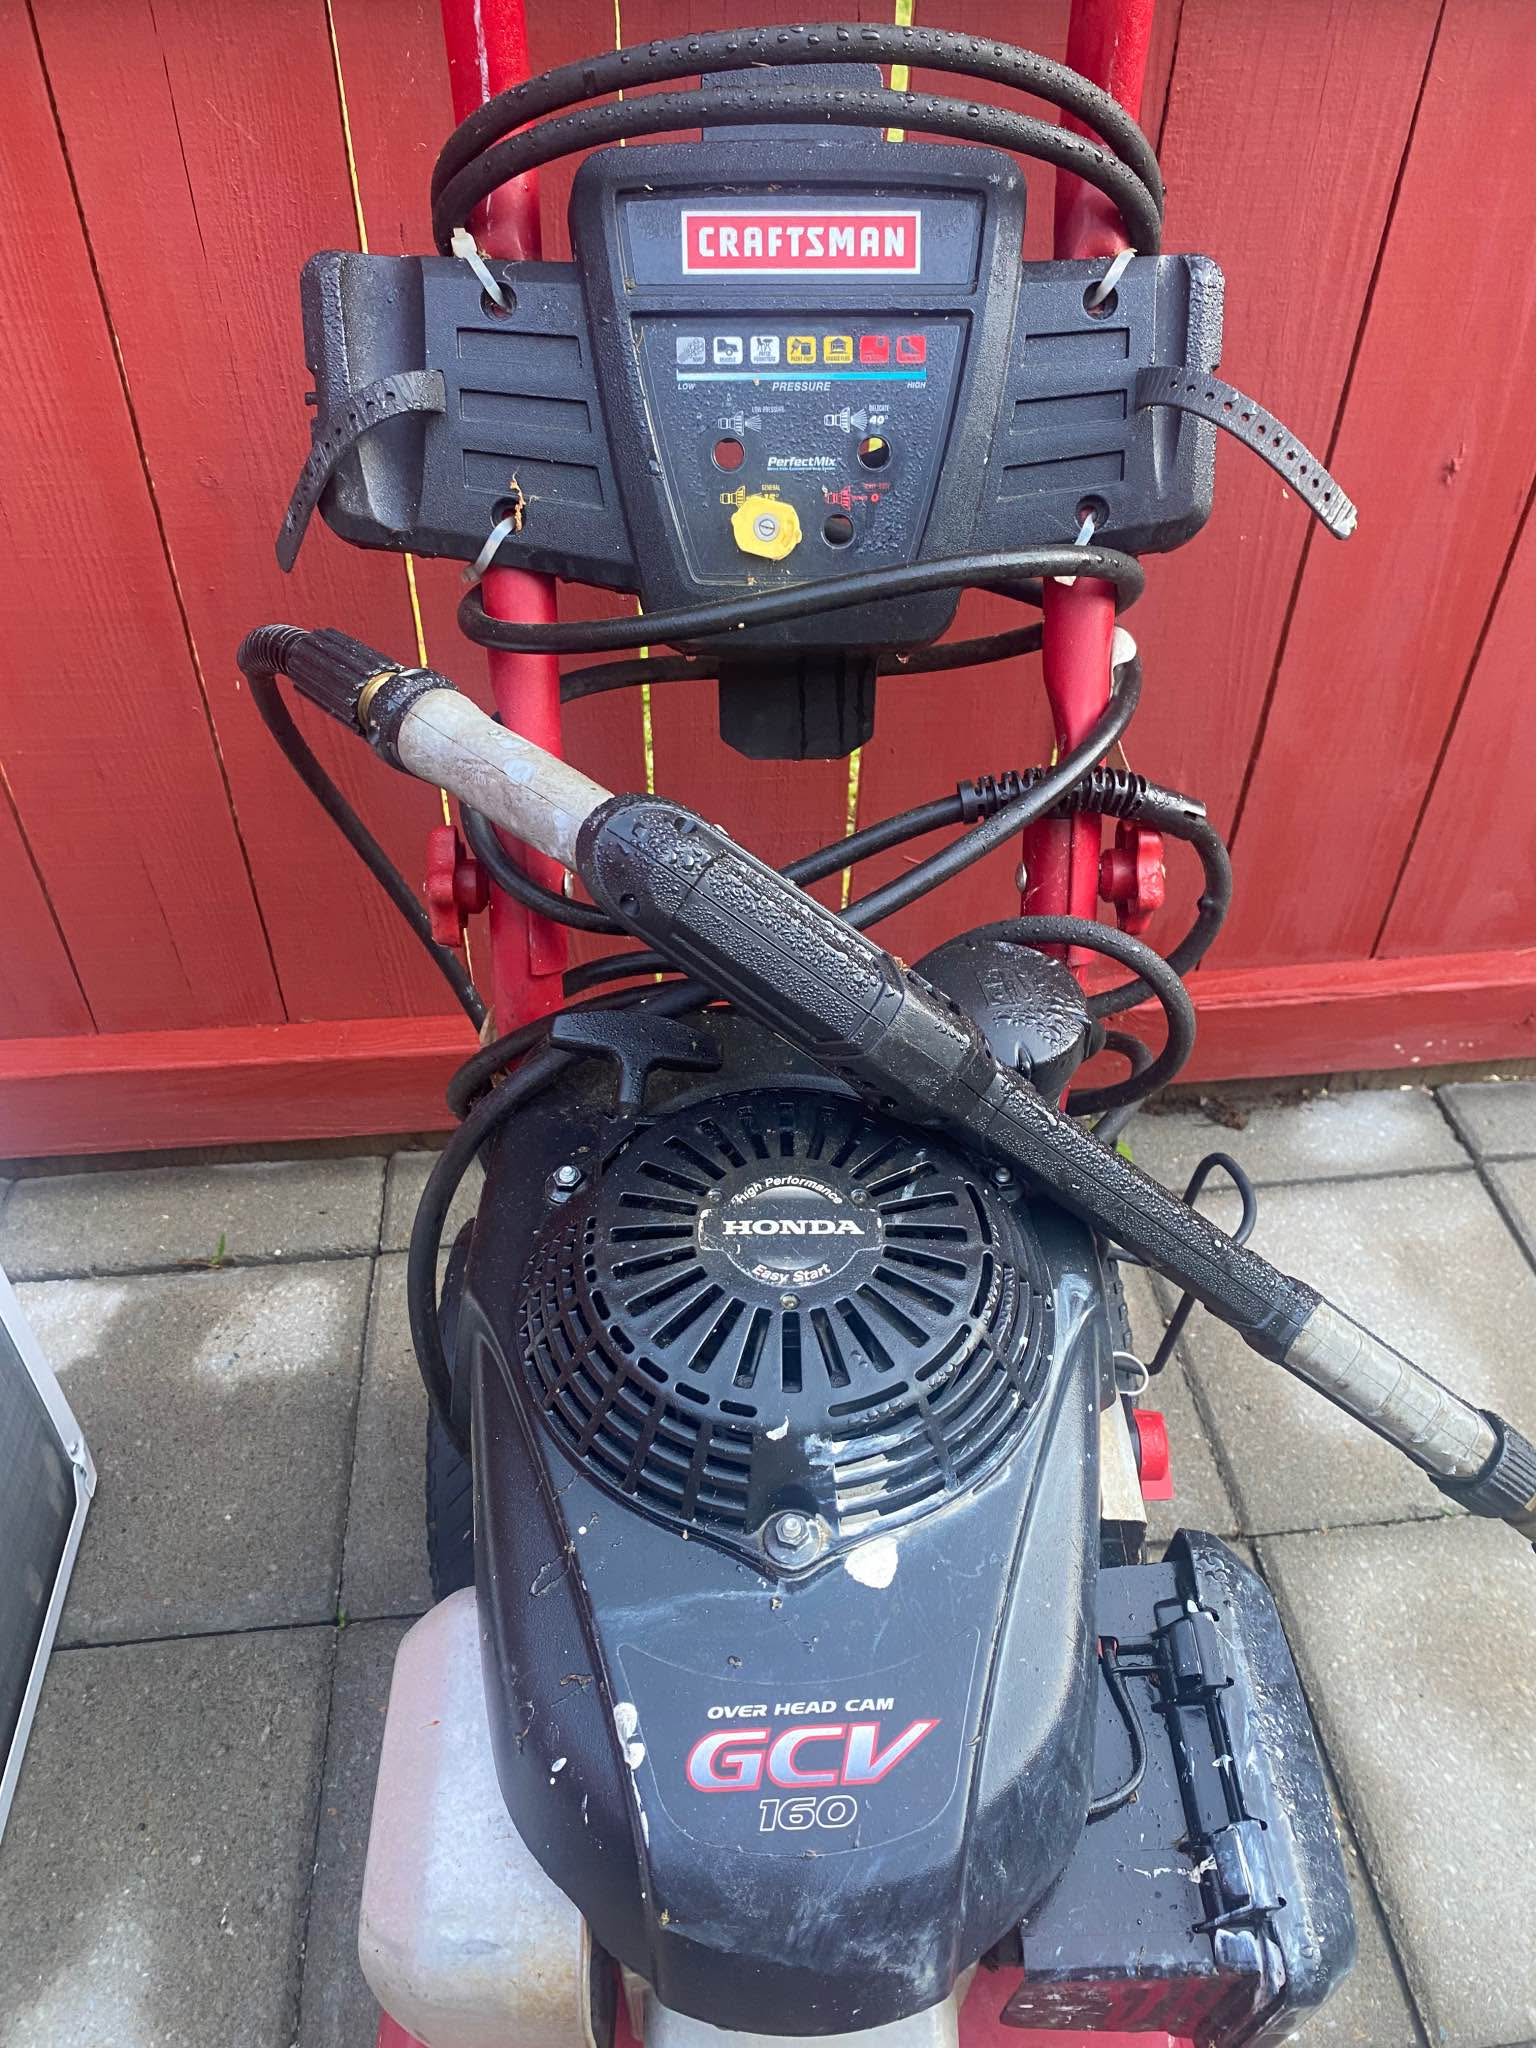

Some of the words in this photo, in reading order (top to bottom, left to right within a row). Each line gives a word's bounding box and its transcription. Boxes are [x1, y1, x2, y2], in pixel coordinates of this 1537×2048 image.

[698, 226, 905, 257] CRAFTSMAN
[772, 382, 831, 391] PRESSURE
[767, 456, 836, 467] PerfectMix
[731, 1181, 763, 1205] High
[765, 1175, 843, 1205] Performance
[722, 1219, 865, 1235] HONDA
[751, 1263, 790, 1284] Easy
[793, 1263, 831, 1283] Start
[707, 1704, 767, 1720] OVER
[774, 1700, 837, 1716] HEAD
[845, 1697, 895, 1712] CAM
[686, 1718, 942, 1793] GCV
[759, 1795, 857, 1832] 160
